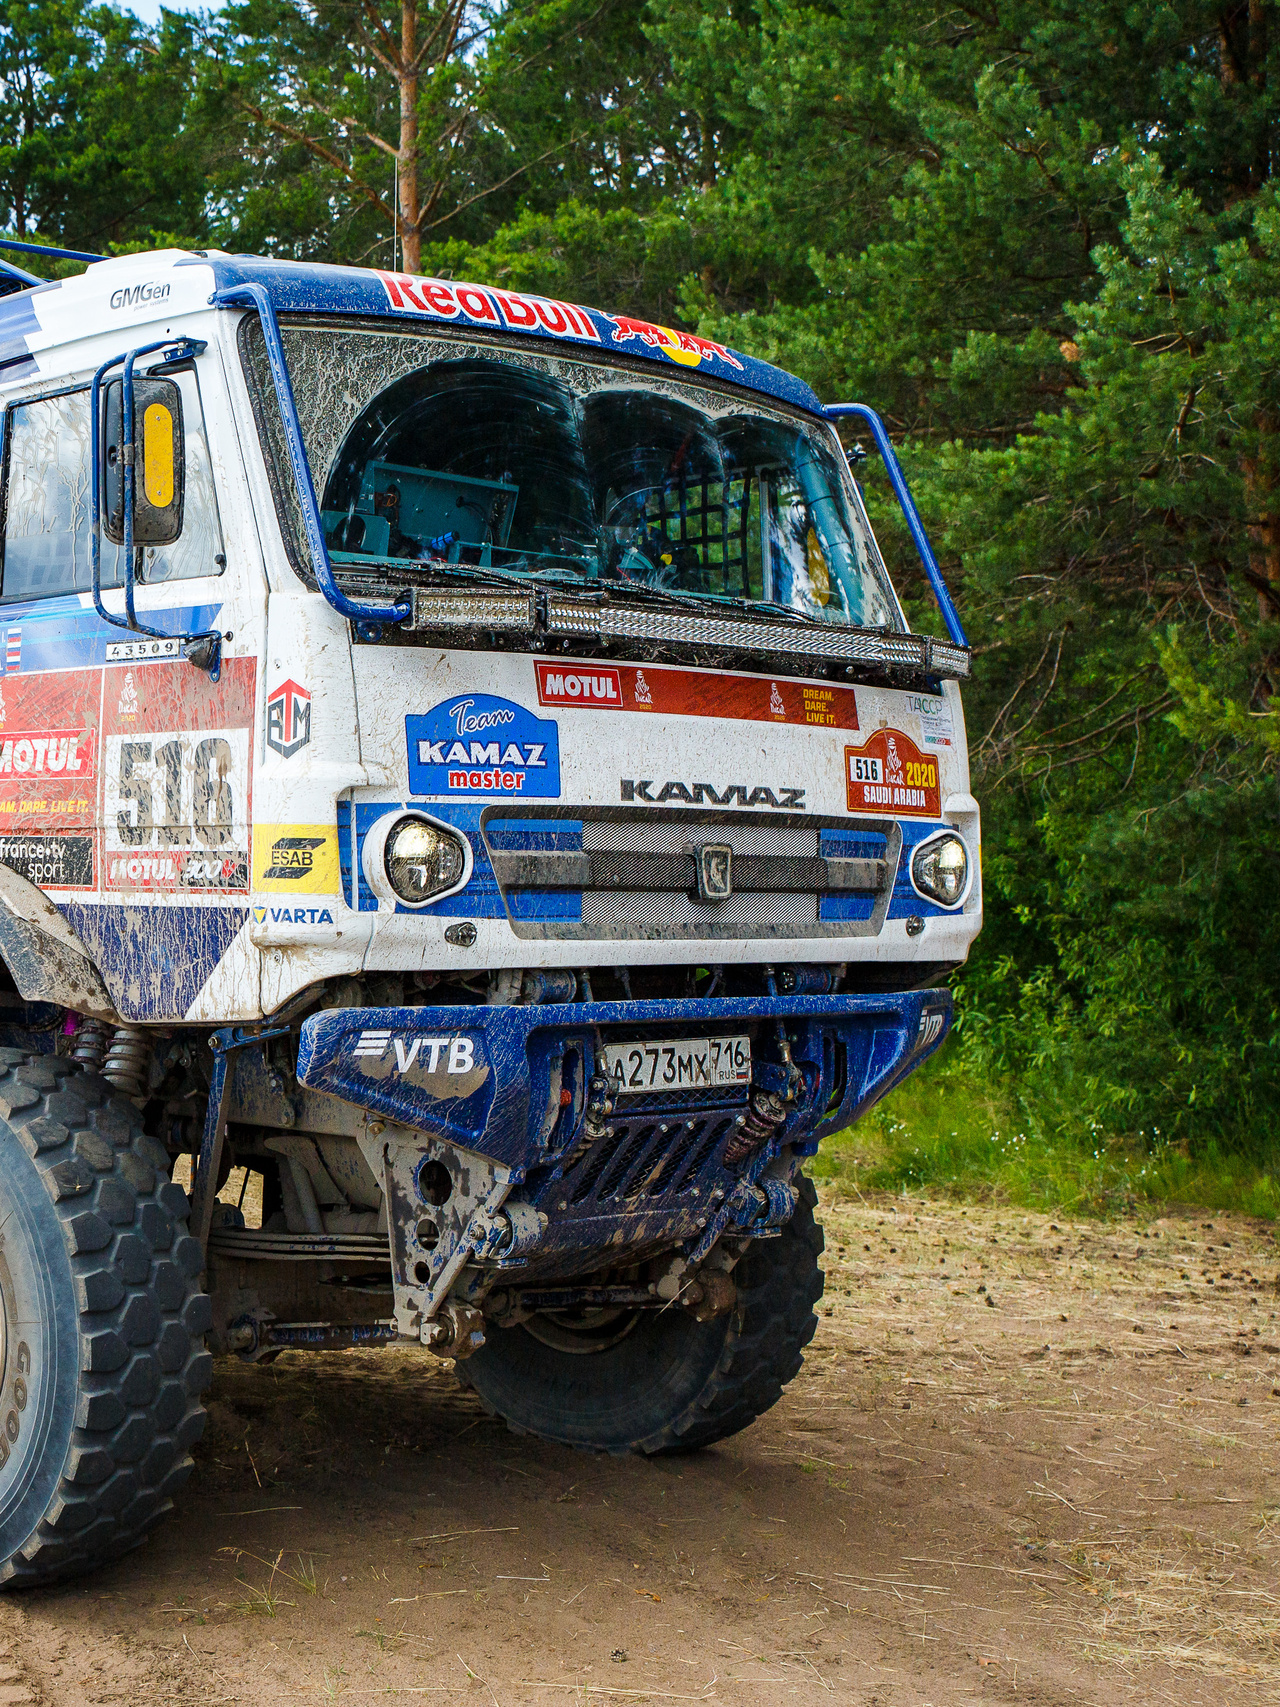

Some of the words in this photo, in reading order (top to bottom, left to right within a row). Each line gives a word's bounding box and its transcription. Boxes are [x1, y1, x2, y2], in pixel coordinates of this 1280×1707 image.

[110, 281, 171, 310] GMGen
[112, 642, 173, 656] 43509
[545, 673, 618, 699] MOTUL
[803, 688, 835, 702] DREAM.
[805, 700, 829, 712] DARE.
[449, 699, 515, 736] Team
[806, 712, 825, 724] LIVE
[826, 714, 837, 725] IT.
[417, 739, 547, 767] KAMAZ
[448, 769, 525, 790] master
[855, 758, 878, 781] 516
[906, 761, 937, 788] 2020
[620, 778, 806, 809] KAMAZ
[863, 785, 892, 805] SAUDI
[893, 787, 926, 807] ARABIA
[271, 849, 314, 866] ESAB
[28, 861, 65, 884] sport
[109, 858, 176, 880] MOTUL
[270, 908, 334, 924] VARTA
[393, 1037, 475, 1074] VTB
[711, 1040, 746, 1070] 716
[719, 1070, 736, 1081] RUS
